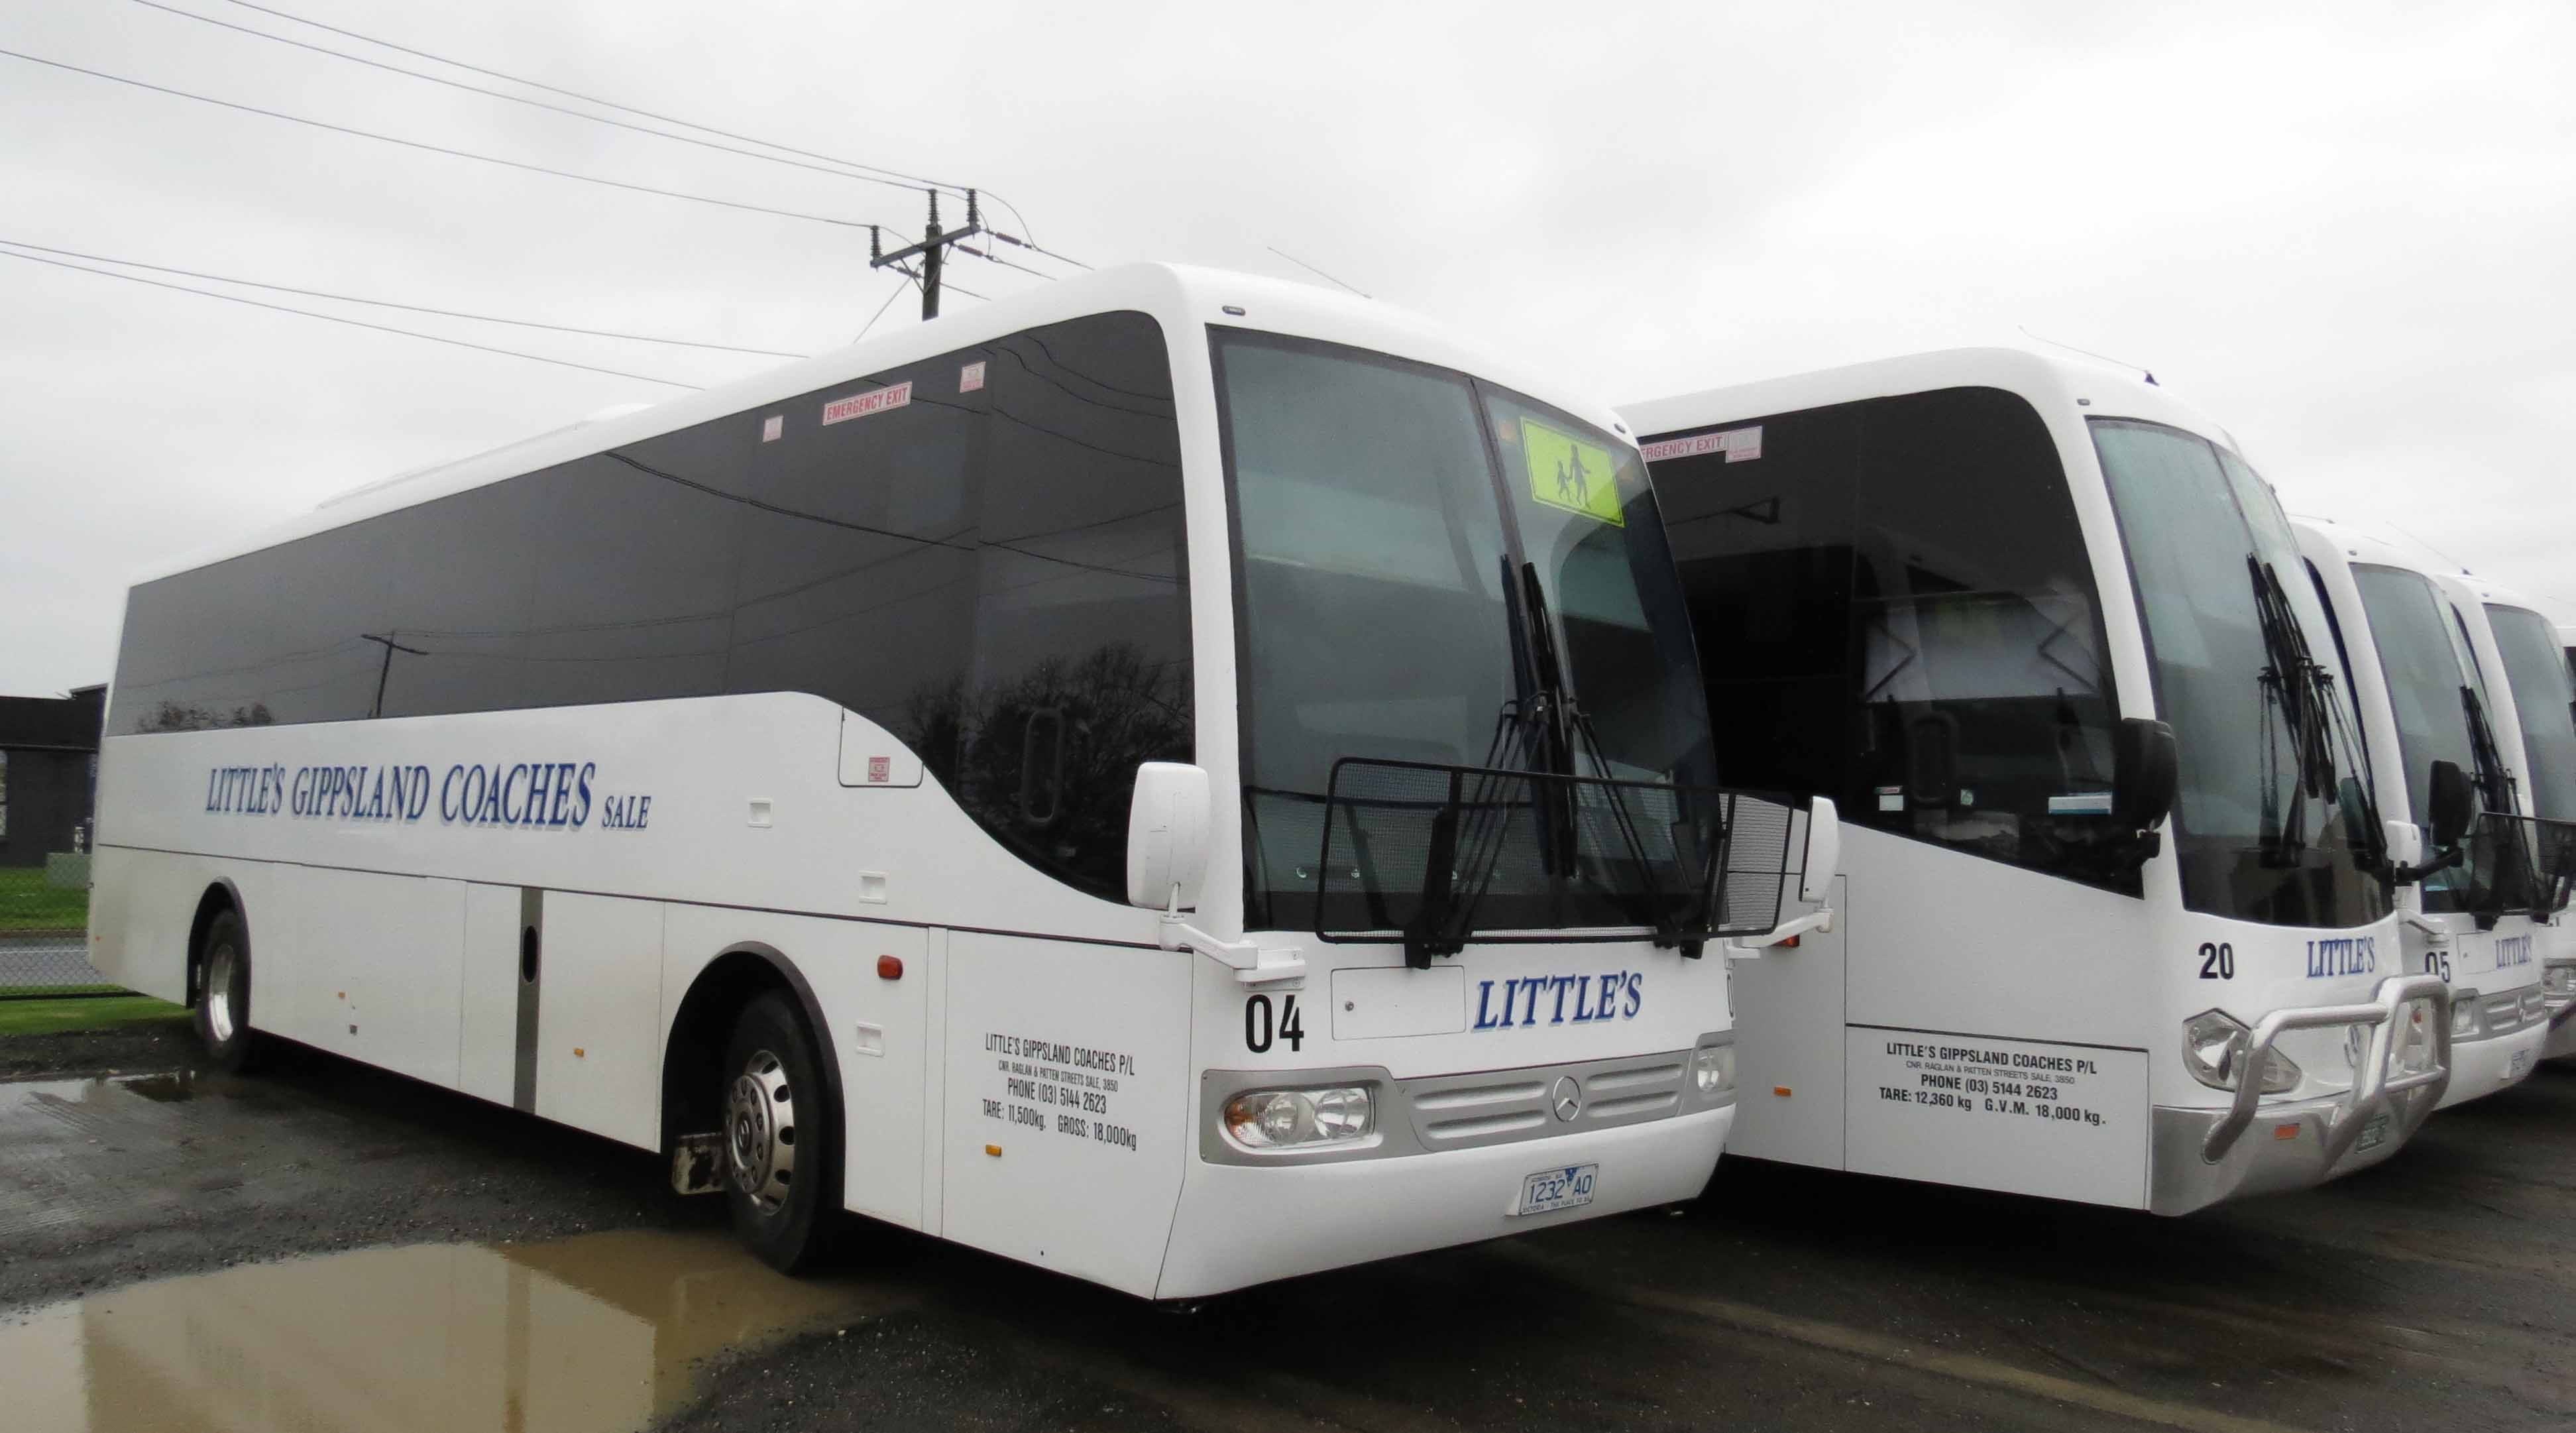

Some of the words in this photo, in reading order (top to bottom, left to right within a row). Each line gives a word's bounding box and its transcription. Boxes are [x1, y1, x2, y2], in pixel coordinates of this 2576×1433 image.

[826, 393, 884, 421] EMERGENCY
[887, 387, 908, 406] EXIT
[1697, 436, 1723, 451] EXIT
[205, 763, 286, 813] LITTLE'S
[292, 765, 430, 821] GIPPSLAND
[441, 762, 596, 827] COACHES
[602, 796, 651, 829] SALE
[2198, 943, 2234, 980] 20
[2306, 937, 2376, 978] LITTLE'S
[1473, 970, 1644, 1031] LITTLE'S
[1245, 994, 1305, 1053] 04
[985, 1033, 1019, 1055] LITTLE'S
[1023, 1039, 1070, 1064] GIPPSLAND
[1074, 1047, 1115, 1072] COACHES
[1119, 1054, 1135, 1076] P/L
[1887, 1043, 1936, 1058] LITTLE'S
[1940, 1047, 2009, 1065] GIPPSLAND
[2013, 1053, 2072, 1072] COACHES
[2077, 1060, 2097, 1074] P/L
[1012, 1062, 1032, 1076] RAGLAN
[1034, 1066, 1038, 1077] &
[1040, 1067, 1059, 1082] PATTEN
[1061, 1072, 1084, 1086] STREETS
[1103, 1078, 1118, 1092] 3850
[1921, 1074, 1961, 1090] PHONE
[1966, 1078, 1988, 1095] (03)
[1993, 1082, 2021, 1096] 5144
[2026, 1085, 2058, 1100] 2623
[1925, 1062, 1954, 1072] RAGLAN
[1964, 1066, 1991, 1076] PATTEN
[1994, 1068, 2028, 1080] STREETS
[2054, 1075, 2075, 1084] 3850
[1008, 1078, 1035, 1100] PHONE
[1038, 1083, 1057, 1105] (03)
[1060, 1088, 1080, 1109] 5144
[1084, 1092, 1106, 1114] 2623
[1879, 1087, 1911, 1102] TARE:
[1915, 1091, 1954, 1107] 12,360
[1958, 1096, 1972, 1112] kg
[1985, 1098, 2029, 1116] G.V.M.
[2035, 1104, 2080, 1121] 18,000
[982, 1099, 1005, 1119] TARE:
[1058, 1114, 1089, 1138] GROSS:
[1093, 1122, 1137, 1151] 18,000kg
[1530, 1179, 1565, 1204] 1232
